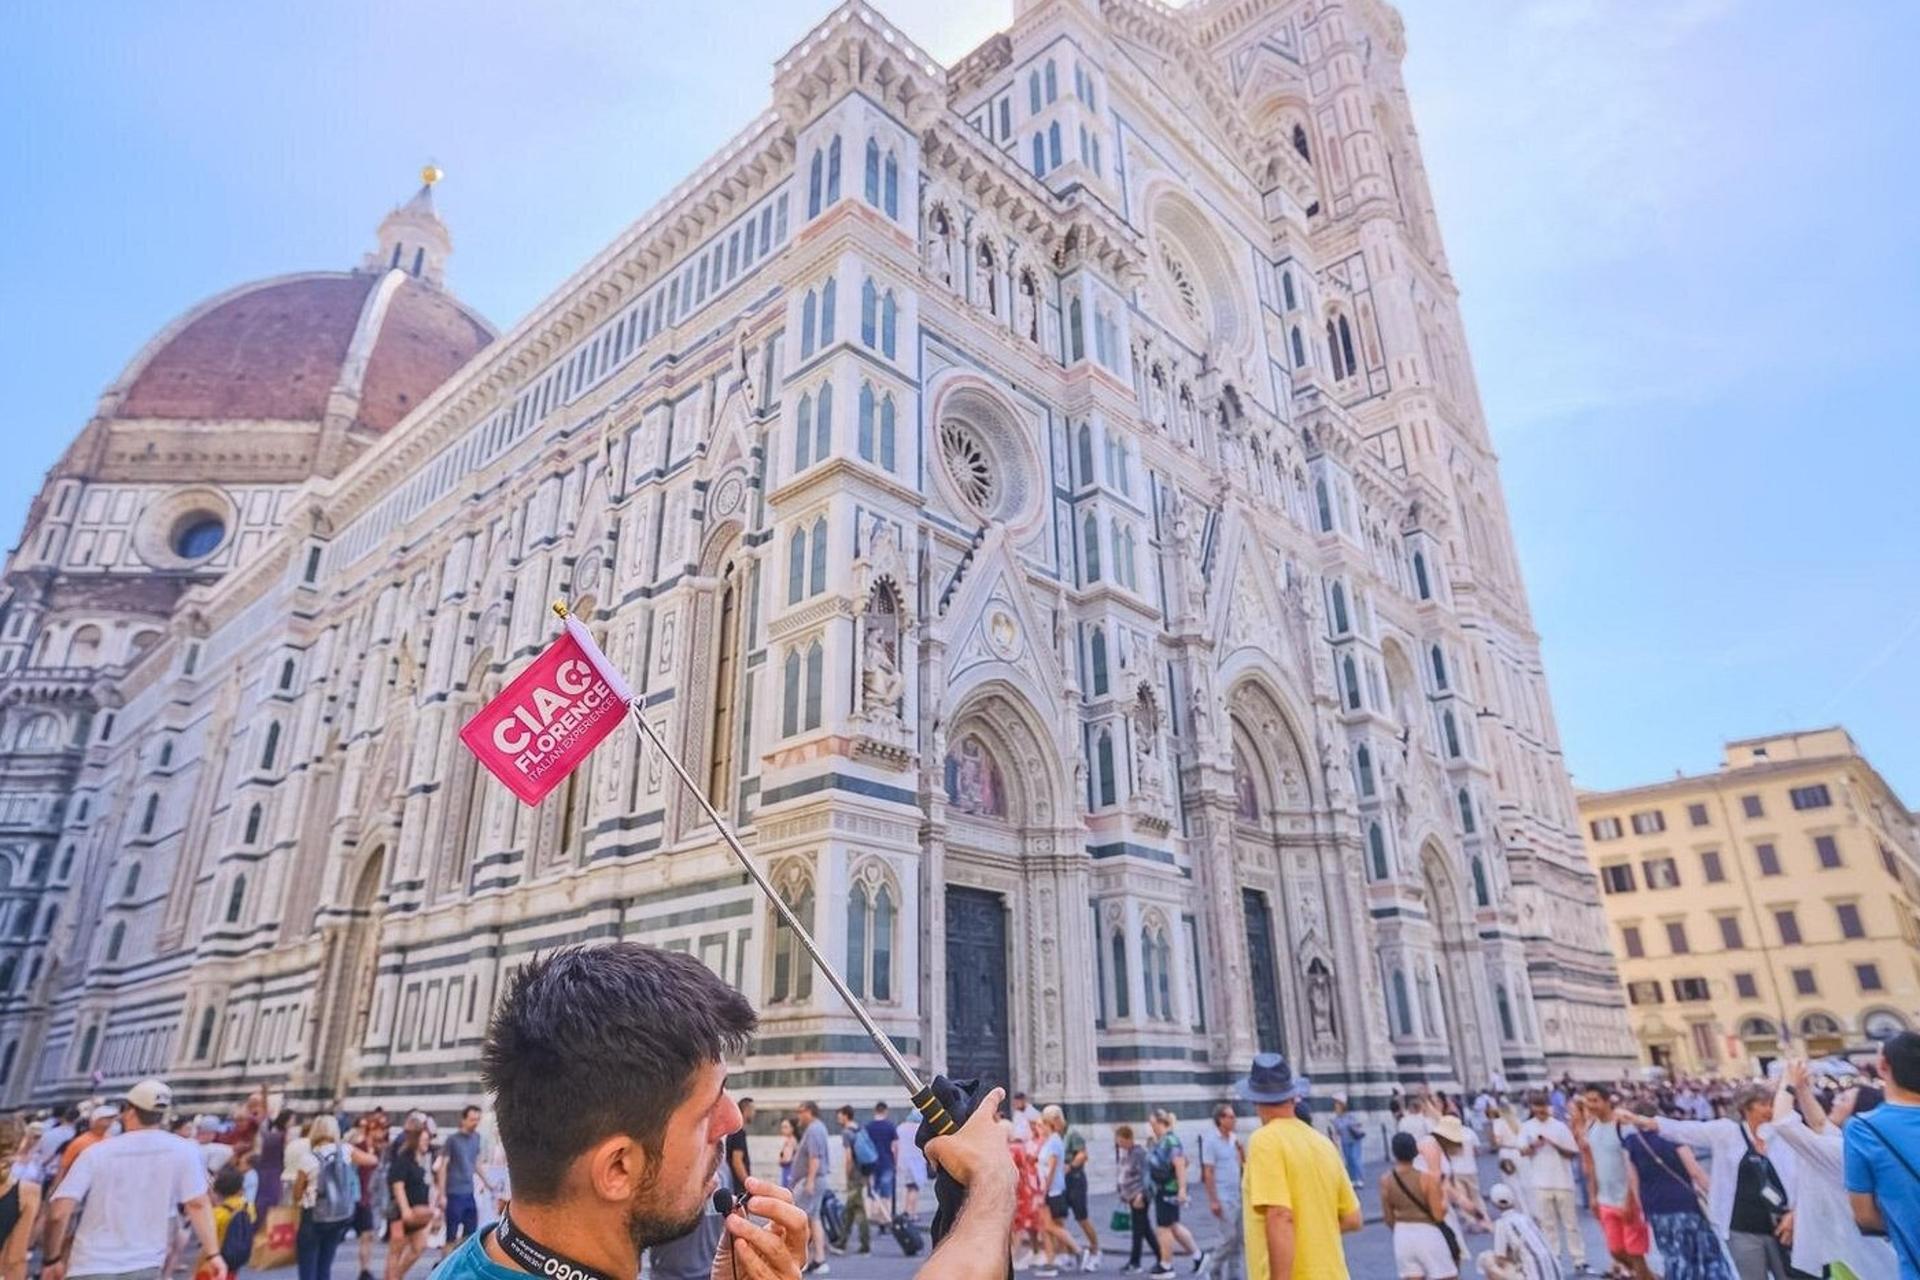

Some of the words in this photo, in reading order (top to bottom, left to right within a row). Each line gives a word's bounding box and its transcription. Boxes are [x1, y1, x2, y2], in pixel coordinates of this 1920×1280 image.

[514, 680, 611, 775] FLORENCE
[528, 746, 567, 783] ITALIAN
[563, 694, 618, 750] EXPERIENCES
